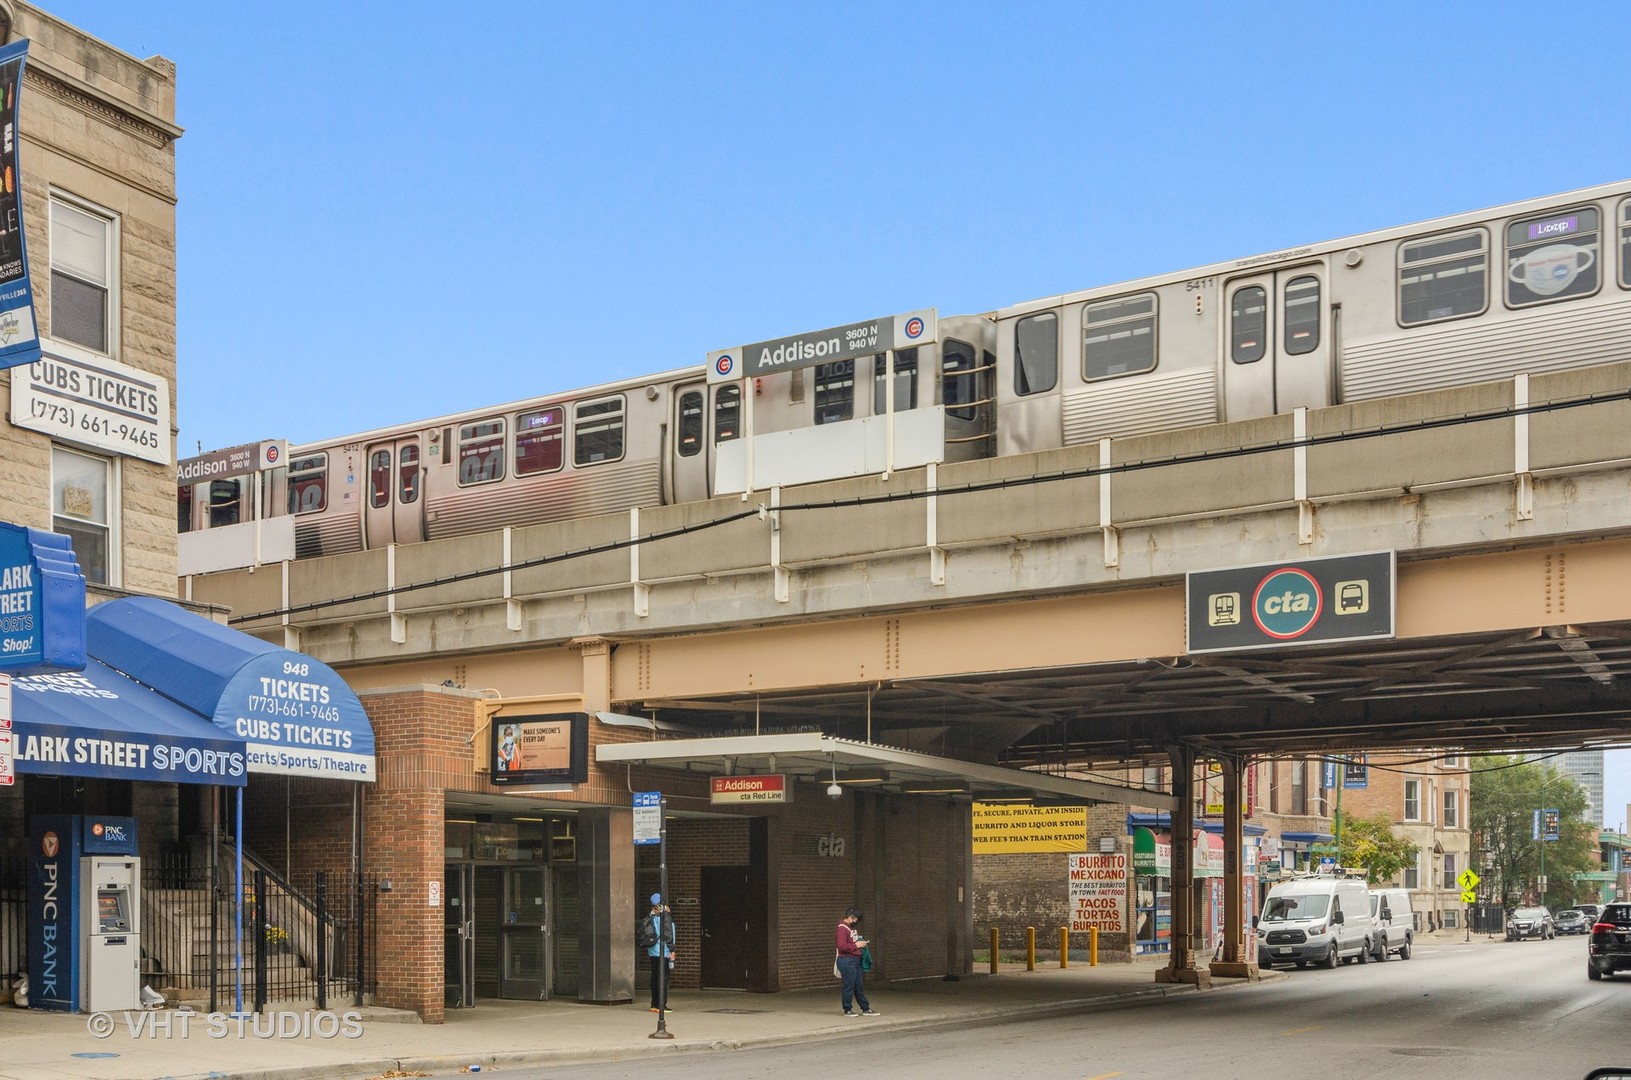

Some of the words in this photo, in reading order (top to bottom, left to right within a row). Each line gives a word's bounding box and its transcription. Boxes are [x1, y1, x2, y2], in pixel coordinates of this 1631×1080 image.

[1537, 221, 1569, 234] Loop
[1186, 278, 1213, 292] 5411
[845, 328, 868, 341] 3600
[870, 324, 878, 335] N
[849, 337, 867, 351] 940
[868, 335, 878, 347] W
[758, 337, 841, 368] Addison
[30, 360, 81, 393] CUBS
[85, 374, 158, 416] TICKETS
[31, 397, 75, 428] (773)
[81, 413, 158, 449] 661-9465
[229, 453, 245, 462] 3600
[245, 451, 250, 459] N
[176, 459, 227, 480] Addison
[232, 461, 243, 470] 940
[242, 460, 250, 468] W
[0, 564, 33, 591] ARK
[0, 591, 33, 614] REET
[1264, 590, 1311, 615] cta
[2, 636, 34, 654] Shop!
[283, 661, 309, 676] 948
[11, 681, 119, 700] SPORTS
[260, 677, 330, 705] TICKETS
[248, 695, 340, 722] (773)-661-9465
[236, 717, 281, 741] CUBS
[283, 723, 353, 749] TICKETS
[523, 728, 536, 736] MAKE
[536, 726, 561, 735] SOMEONE'S
[537, 735, 546, 743] DAY
[74, 738, 149, 769] STREET
[152, 744, 244, 777] SPORTS
[724, 780, 763, 790] Addison
[753, 792, 766, 800] Red
[767, 791, 782, 800] Line
[984, 809, 1012, 817] SECURE,
[1013, 808, 1044, 816] PRIVATE,
[105, 826, 123, 835] PNC
[975, 822, 1009, 830] BURRITO
[1010, 821, 1027, 829] AND
[1029, 821, 1058, 829] LIQUOR
[105, 833, 127, 842] BANK
[817, 831, 846, 857] cta
[1009, 835, 1029, 843] THAN
[1030, 834, 1053, 842] TRAIN
[1054, 833, 1085, 841] STATION
[1079, 855, 1125, 869] BURRITO
[1133, 859, 1156, 867] BURRITO
[1071, 869, 1125, 880] MEXICANO
[43, 861, 58, 920] PNC
[1078, 898, 1117, 909] TACOS
[1076, 909, 1120, 920] TORTAS
[1073, 920, 1122, 931] BURRITOS
[42, 922, 58, 998] BANK
